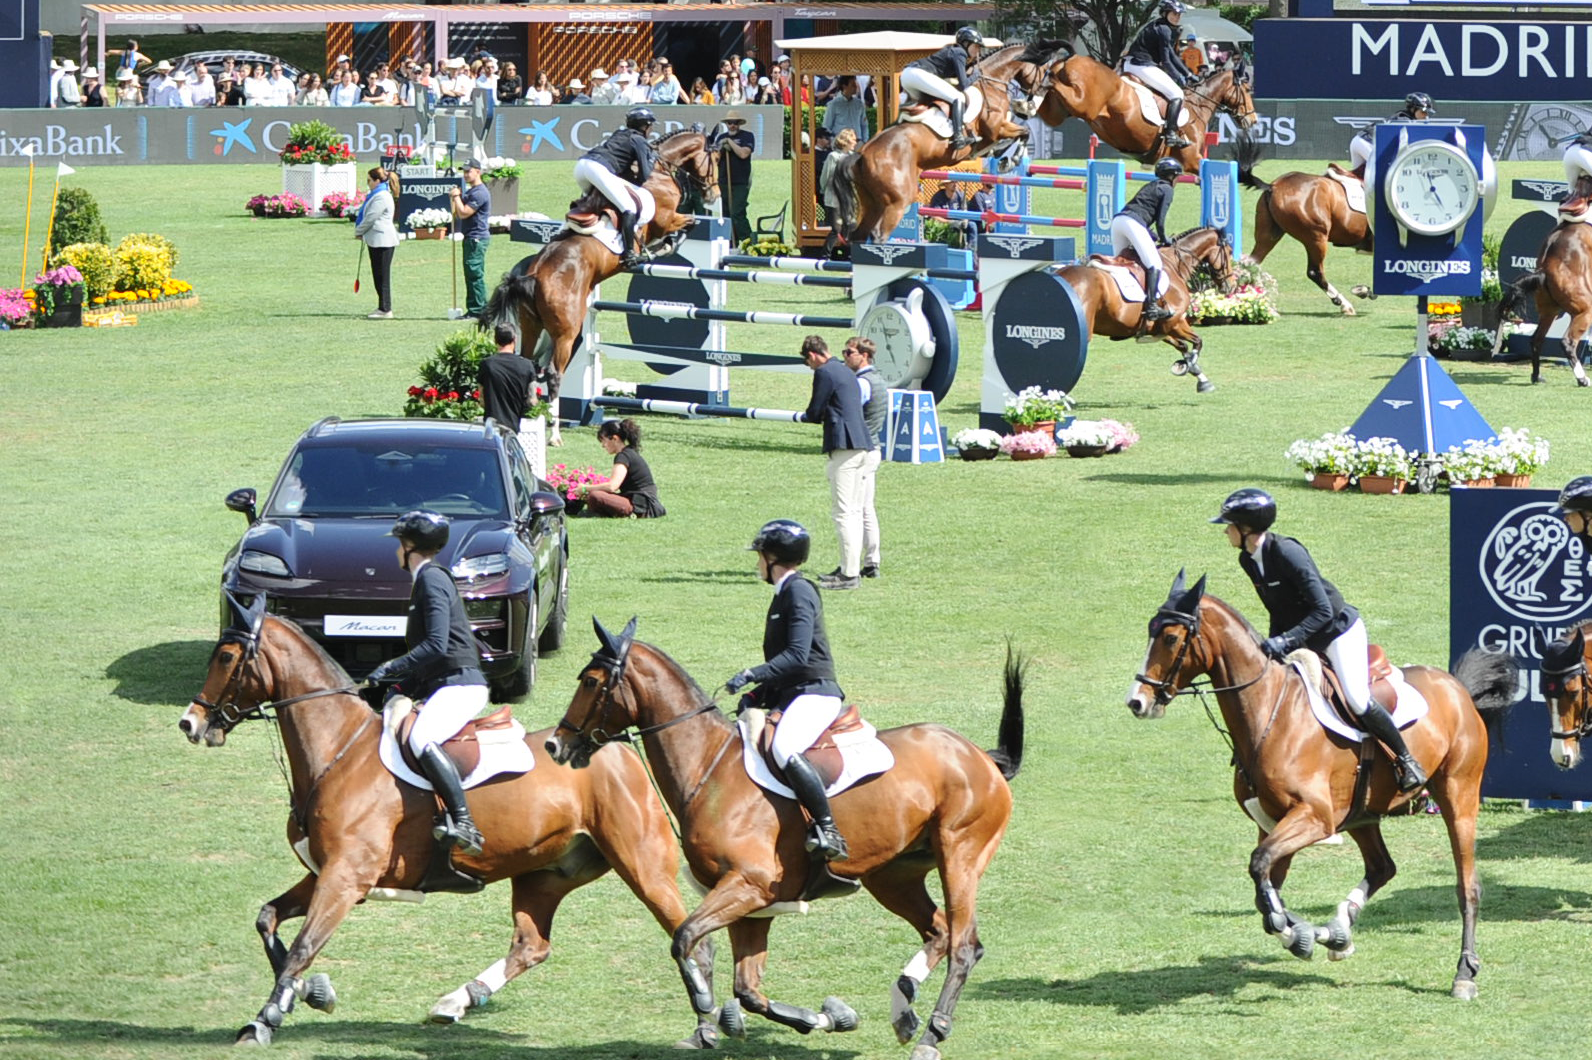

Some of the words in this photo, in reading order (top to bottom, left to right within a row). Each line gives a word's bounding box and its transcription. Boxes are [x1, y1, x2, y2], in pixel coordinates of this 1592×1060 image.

[569, 11, 652, 20] PORSCHE
[406, 168, 429, 177] START
[1384, 259, 1471, 275] LONGINES
[1006, 324, 1066, 341] LONGINES
[900, 421, 910, 435] A
[922, 420, 934, 436] A
[339, 621, 397, 631] Macan
